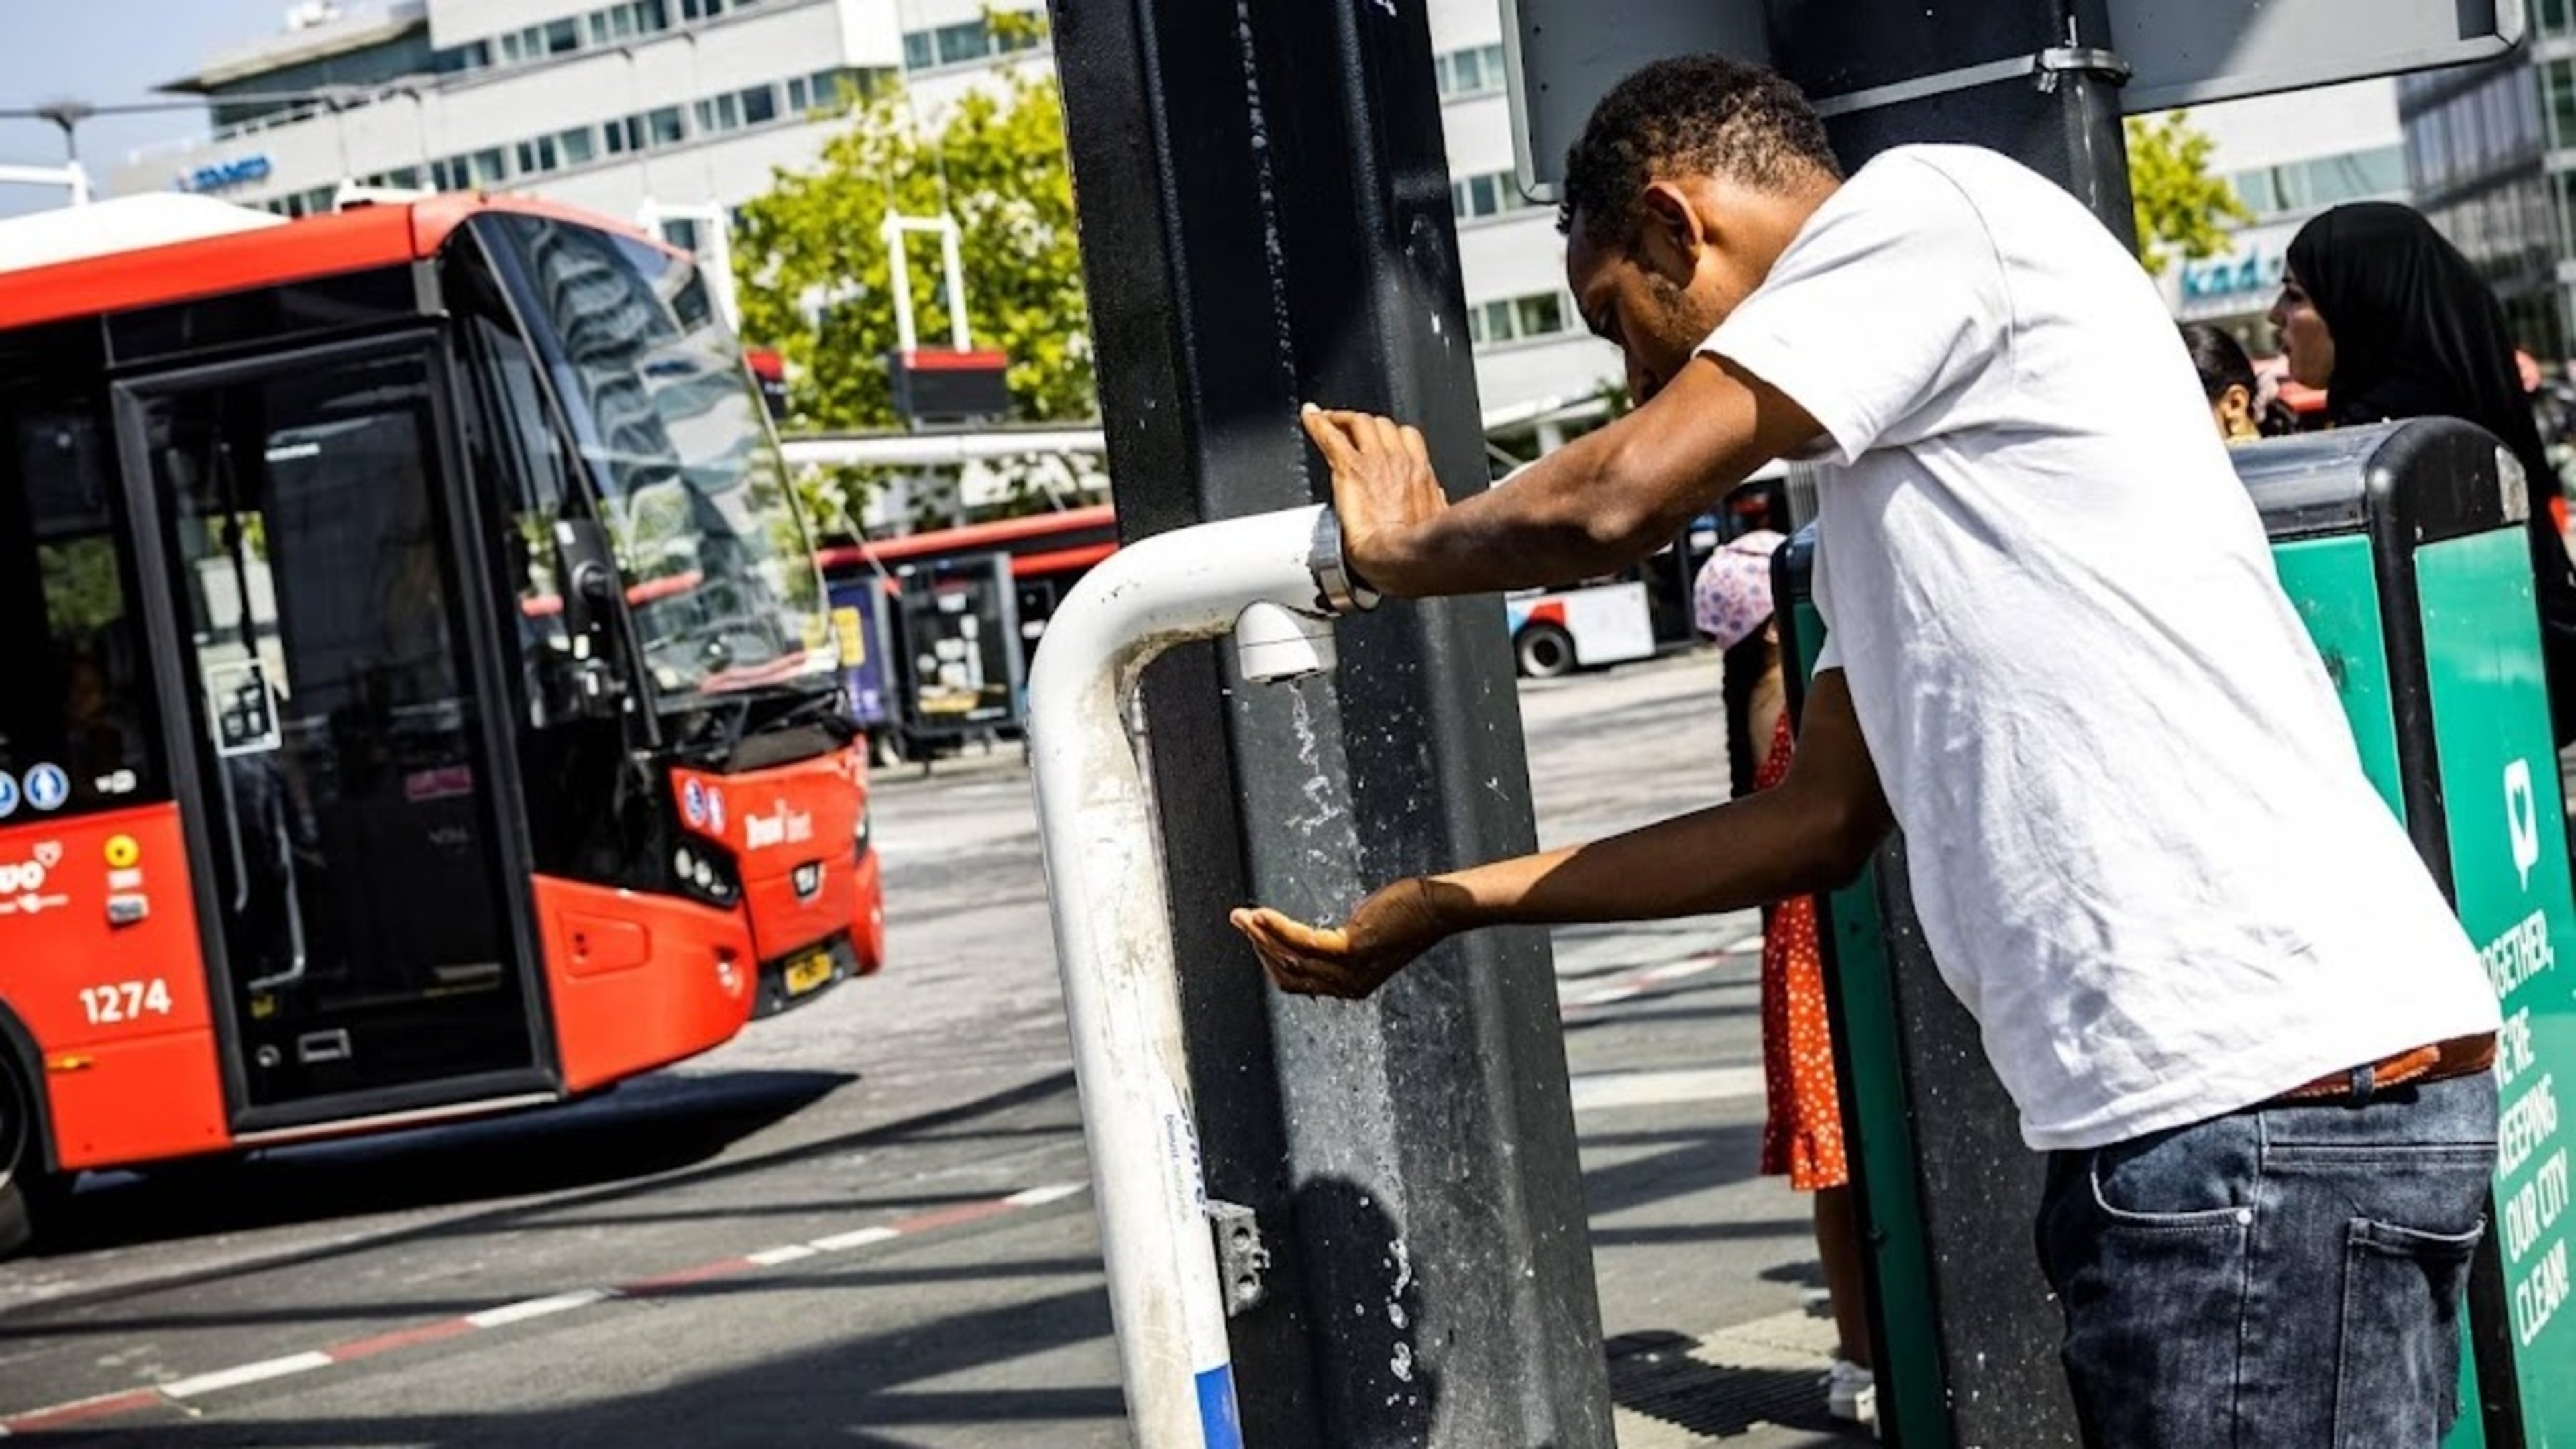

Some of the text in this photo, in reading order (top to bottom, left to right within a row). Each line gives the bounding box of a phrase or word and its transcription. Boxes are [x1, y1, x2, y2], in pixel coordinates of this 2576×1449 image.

[79, 977, 172, 1025] 1274
[2481, 908, 2555, 1000] OGETHER,
[2498, 1073, 2557, 1181] KEEPING
[2505, 1146, 2569, 1264] OUR CITY
